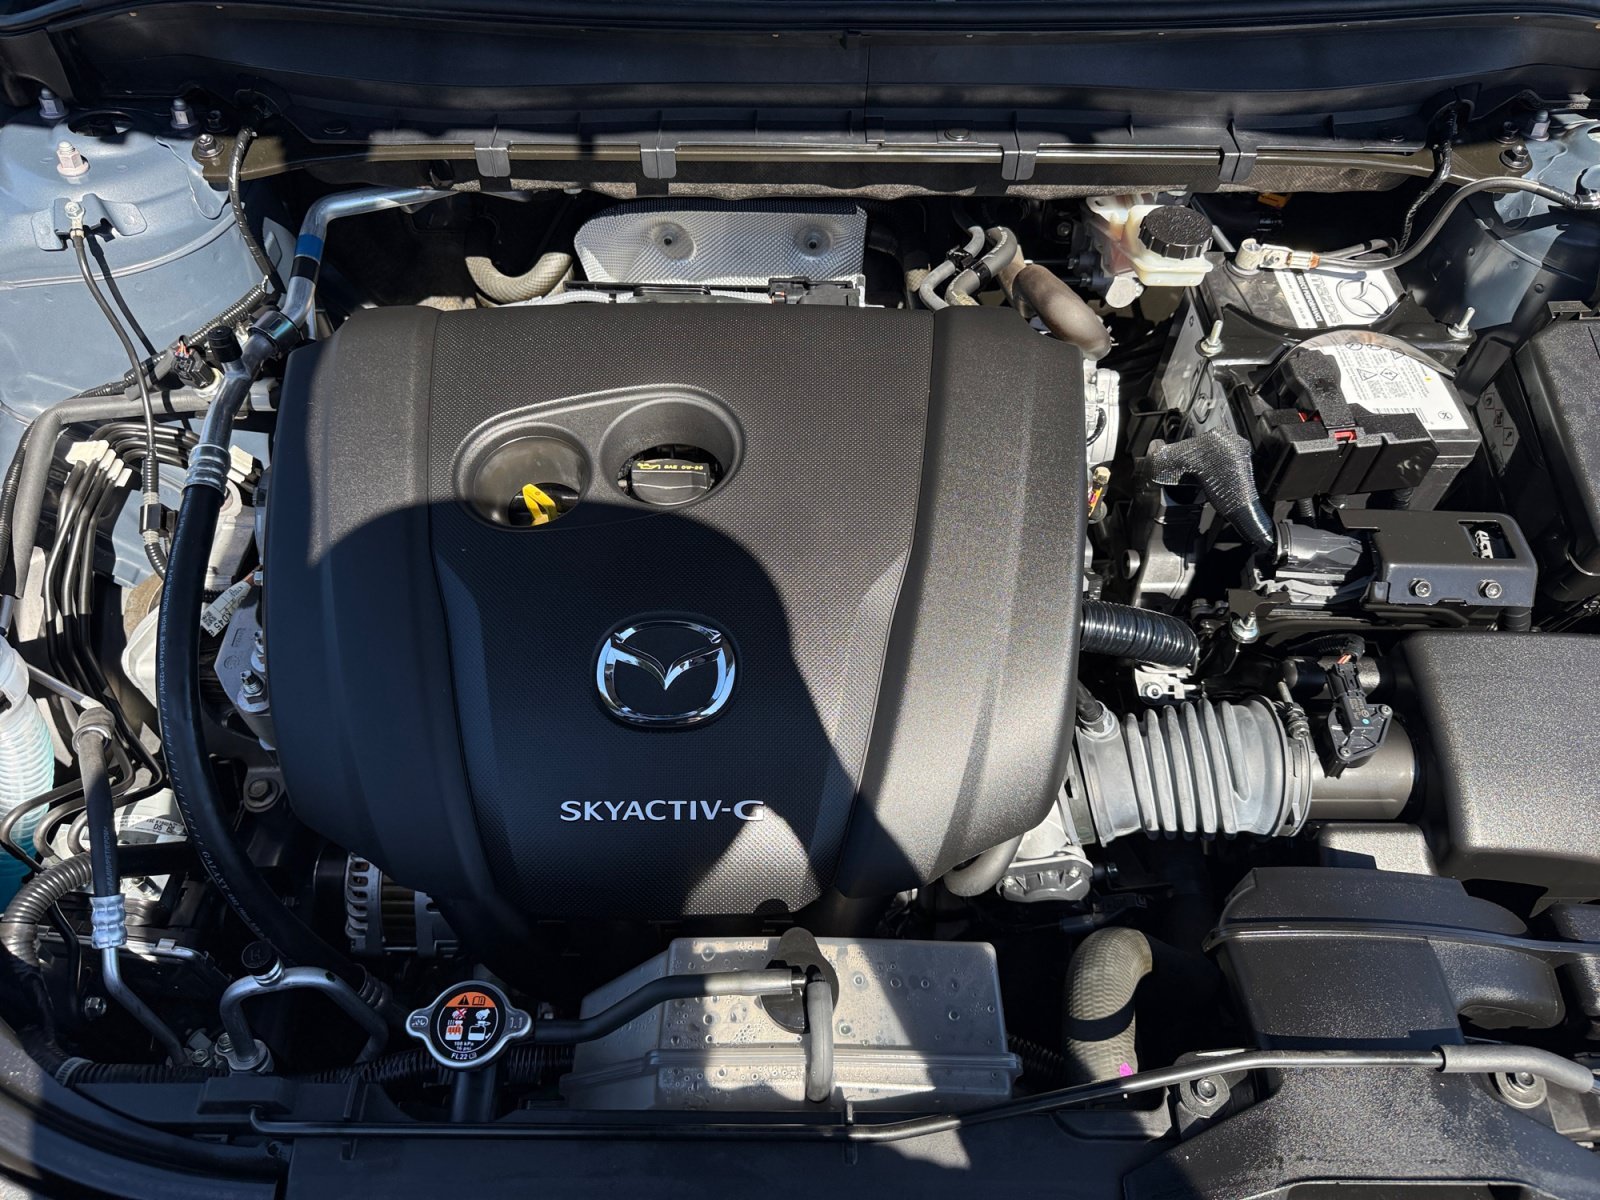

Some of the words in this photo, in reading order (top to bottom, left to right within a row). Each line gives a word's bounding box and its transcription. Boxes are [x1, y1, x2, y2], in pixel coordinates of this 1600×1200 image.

[1303, 289, 1324, 322] PERFORMANCE
[560, 799, 764, 821] SKYACTIV-G
[202, 851, 230, 891] GALAXY
[450, 1052, 468, 1060] FL22
